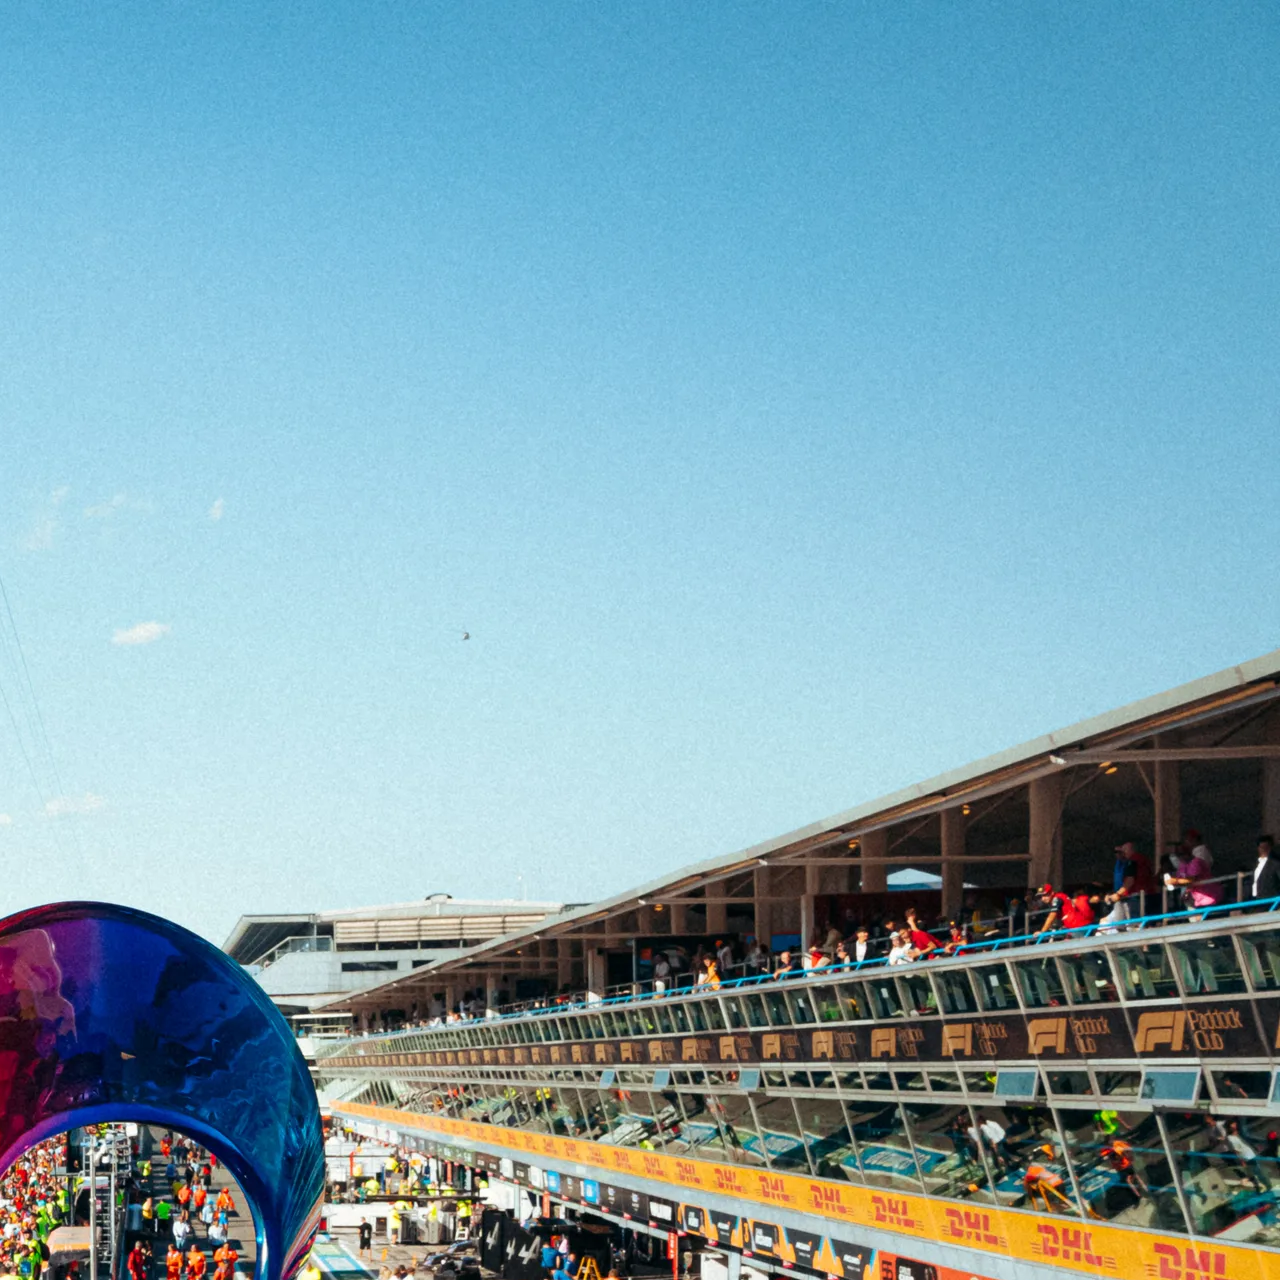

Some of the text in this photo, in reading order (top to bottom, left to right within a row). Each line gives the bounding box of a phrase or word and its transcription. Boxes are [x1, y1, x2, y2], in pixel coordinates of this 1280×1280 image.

[1189, 1008, 1243, 1031] Paddock
[1193, 1029, 1225, 1051] Club
[714, 1168, 743, 1193] DHL
[759, 1175, 790, 1202] DHL
[810, 1185, 848, 1214] DHL
[872, 1195, 915, 1228] DHL
[945, 1208, 998, 1246] DHL
[518, 1235, 541, 1265] 4
[1037, 1224, 1103, 1268] DHL
